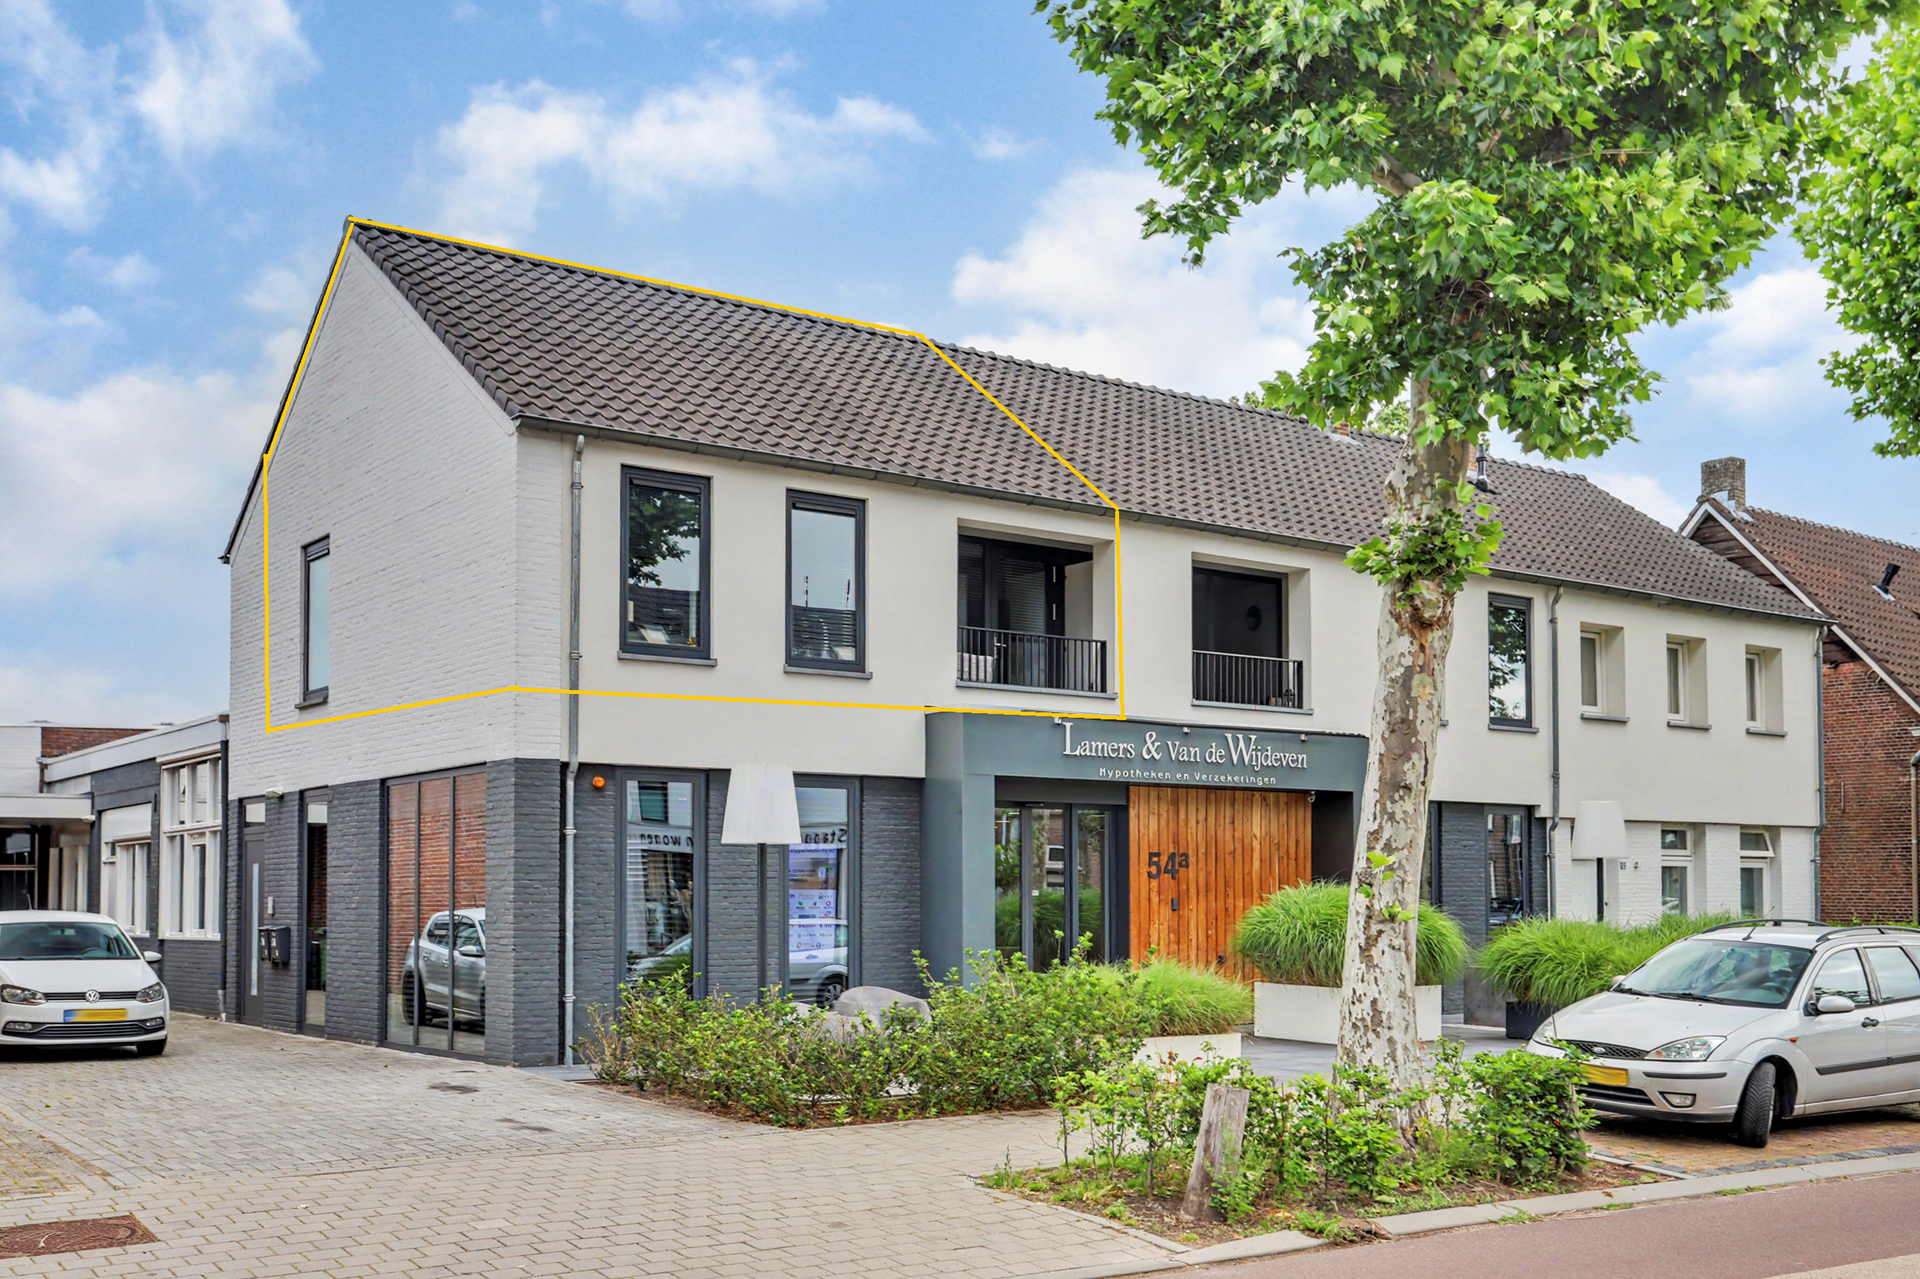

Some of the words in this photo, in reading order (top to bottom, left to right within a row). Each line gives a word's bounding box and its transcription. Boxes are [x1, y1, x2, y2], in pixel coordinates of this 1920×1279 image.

[1062, 722, 1136, 759] Lamers
[1142, 731, 1162, 760] &
[1167, 741, 1201, 762] Van
[1205, 742, 1226, 763] de
[1224, 733, 1307, 771] Wijdeven
[1099, 767, 1171, 780] Hypotheken
[1176, 773, 1189, 781] en
[1194, 772, 1276, 786] Verzekeringen
[1147, 852, 1189, 880] 54a
